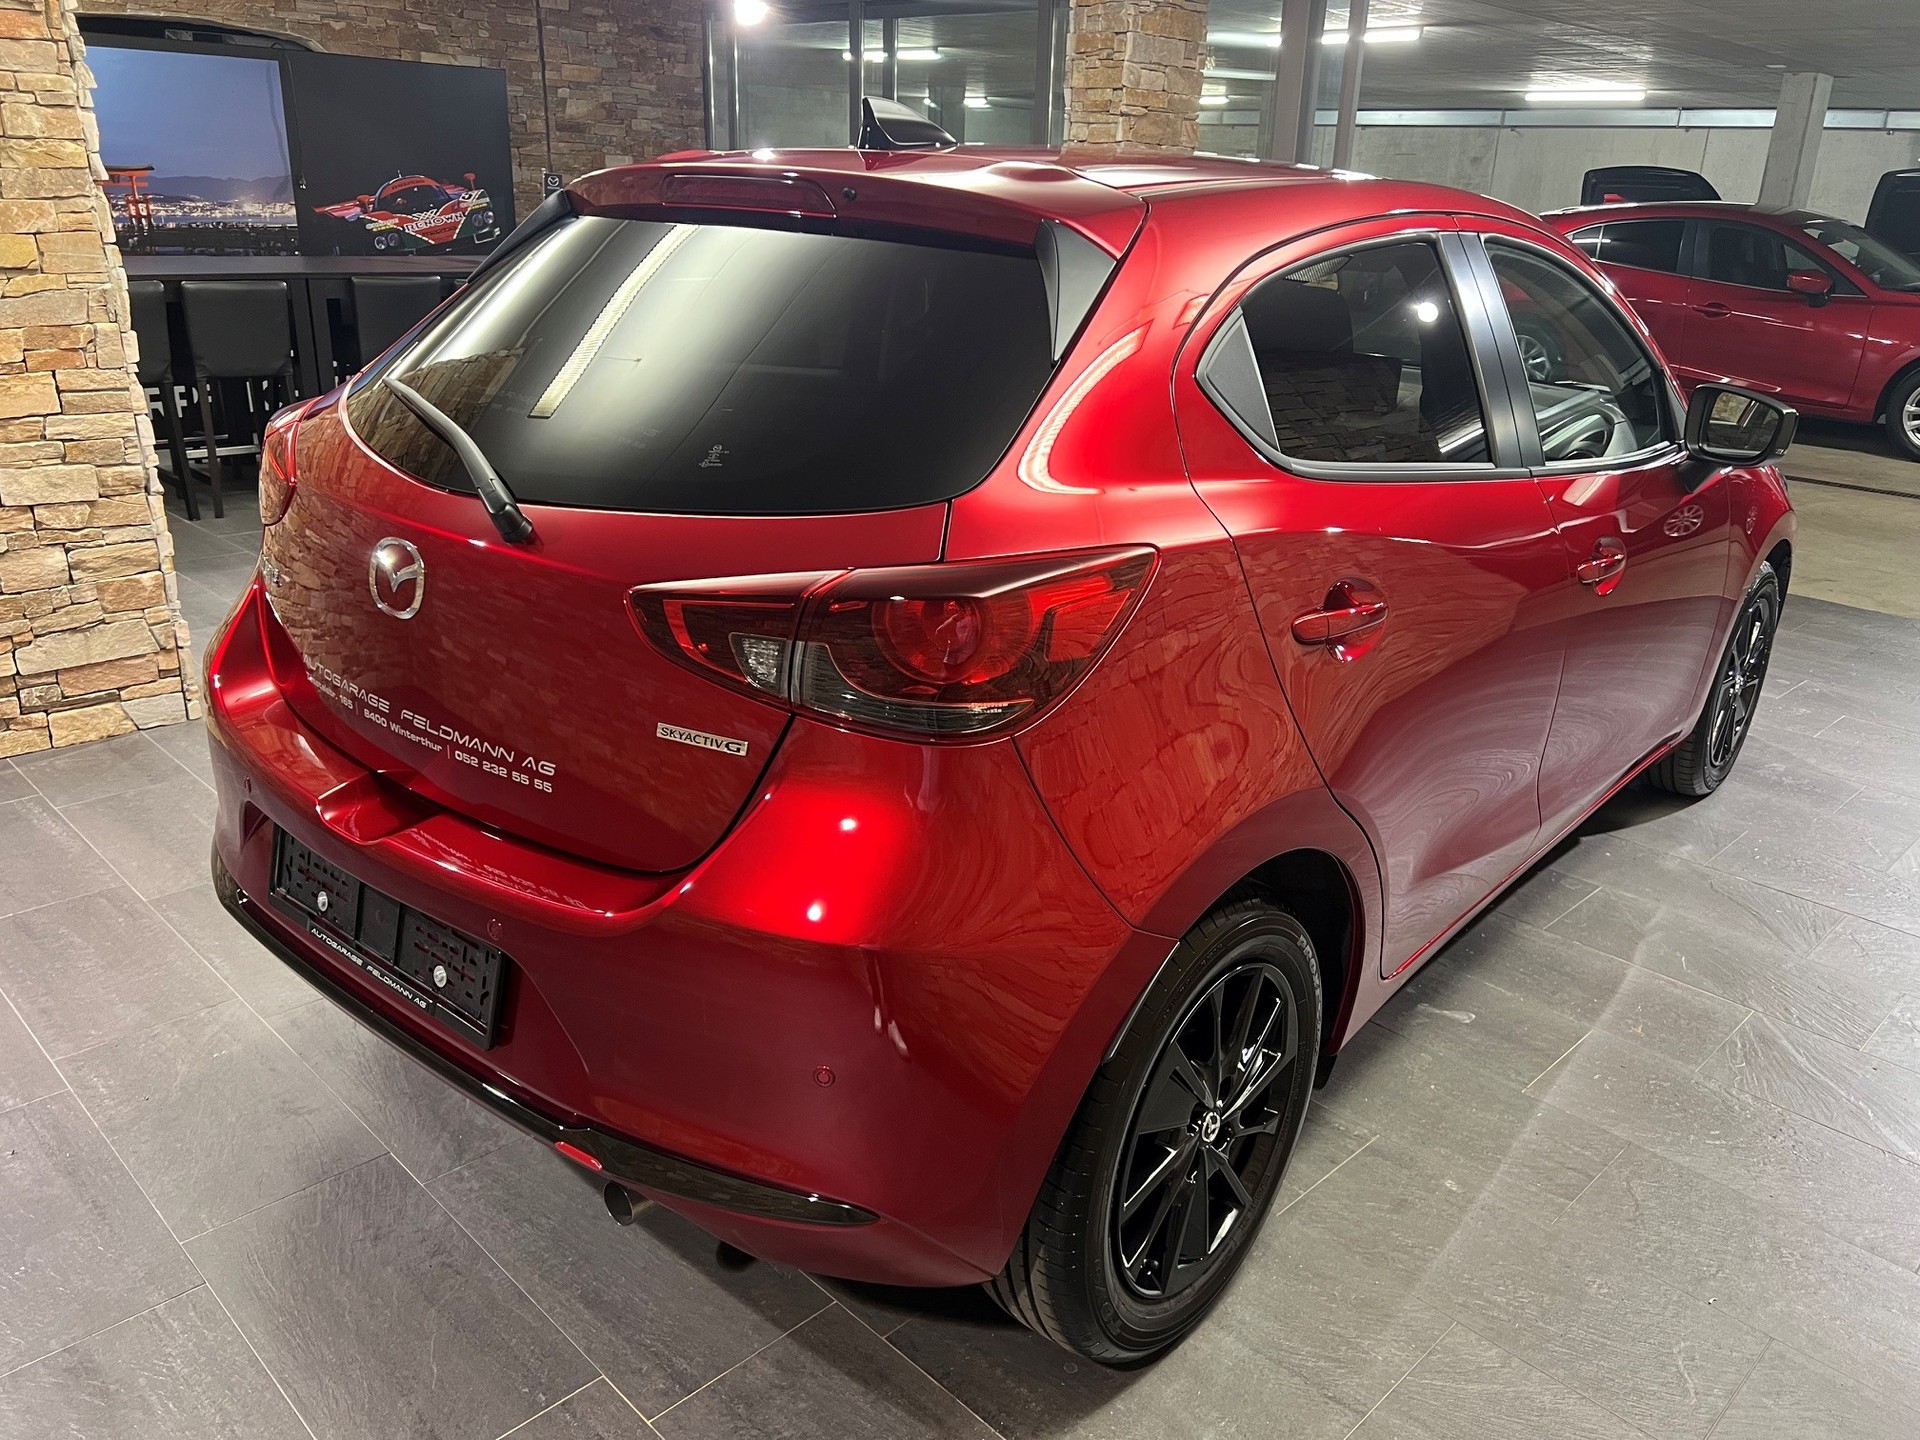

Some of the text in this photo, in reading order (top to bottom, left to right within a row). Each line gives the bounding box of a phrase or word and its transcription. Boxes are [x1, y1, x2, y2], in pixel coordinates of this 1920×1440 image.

[404, 211, 466, 233] RENOWN
[303, 654, 557, 777] AUTOGARAGE FELDMANN AG
[363, 708, 388, 728] 8400
[389, 721, 443, 752] Winterthur
[454, 750, 479, 768] 052
[482, 760, 508, 778] 232
[511, 771, 530, 786] 55
[534, 778, 553, 794] 55
[311, 928, 427, 1009] AUTOGARAGE FELDMANN AG
